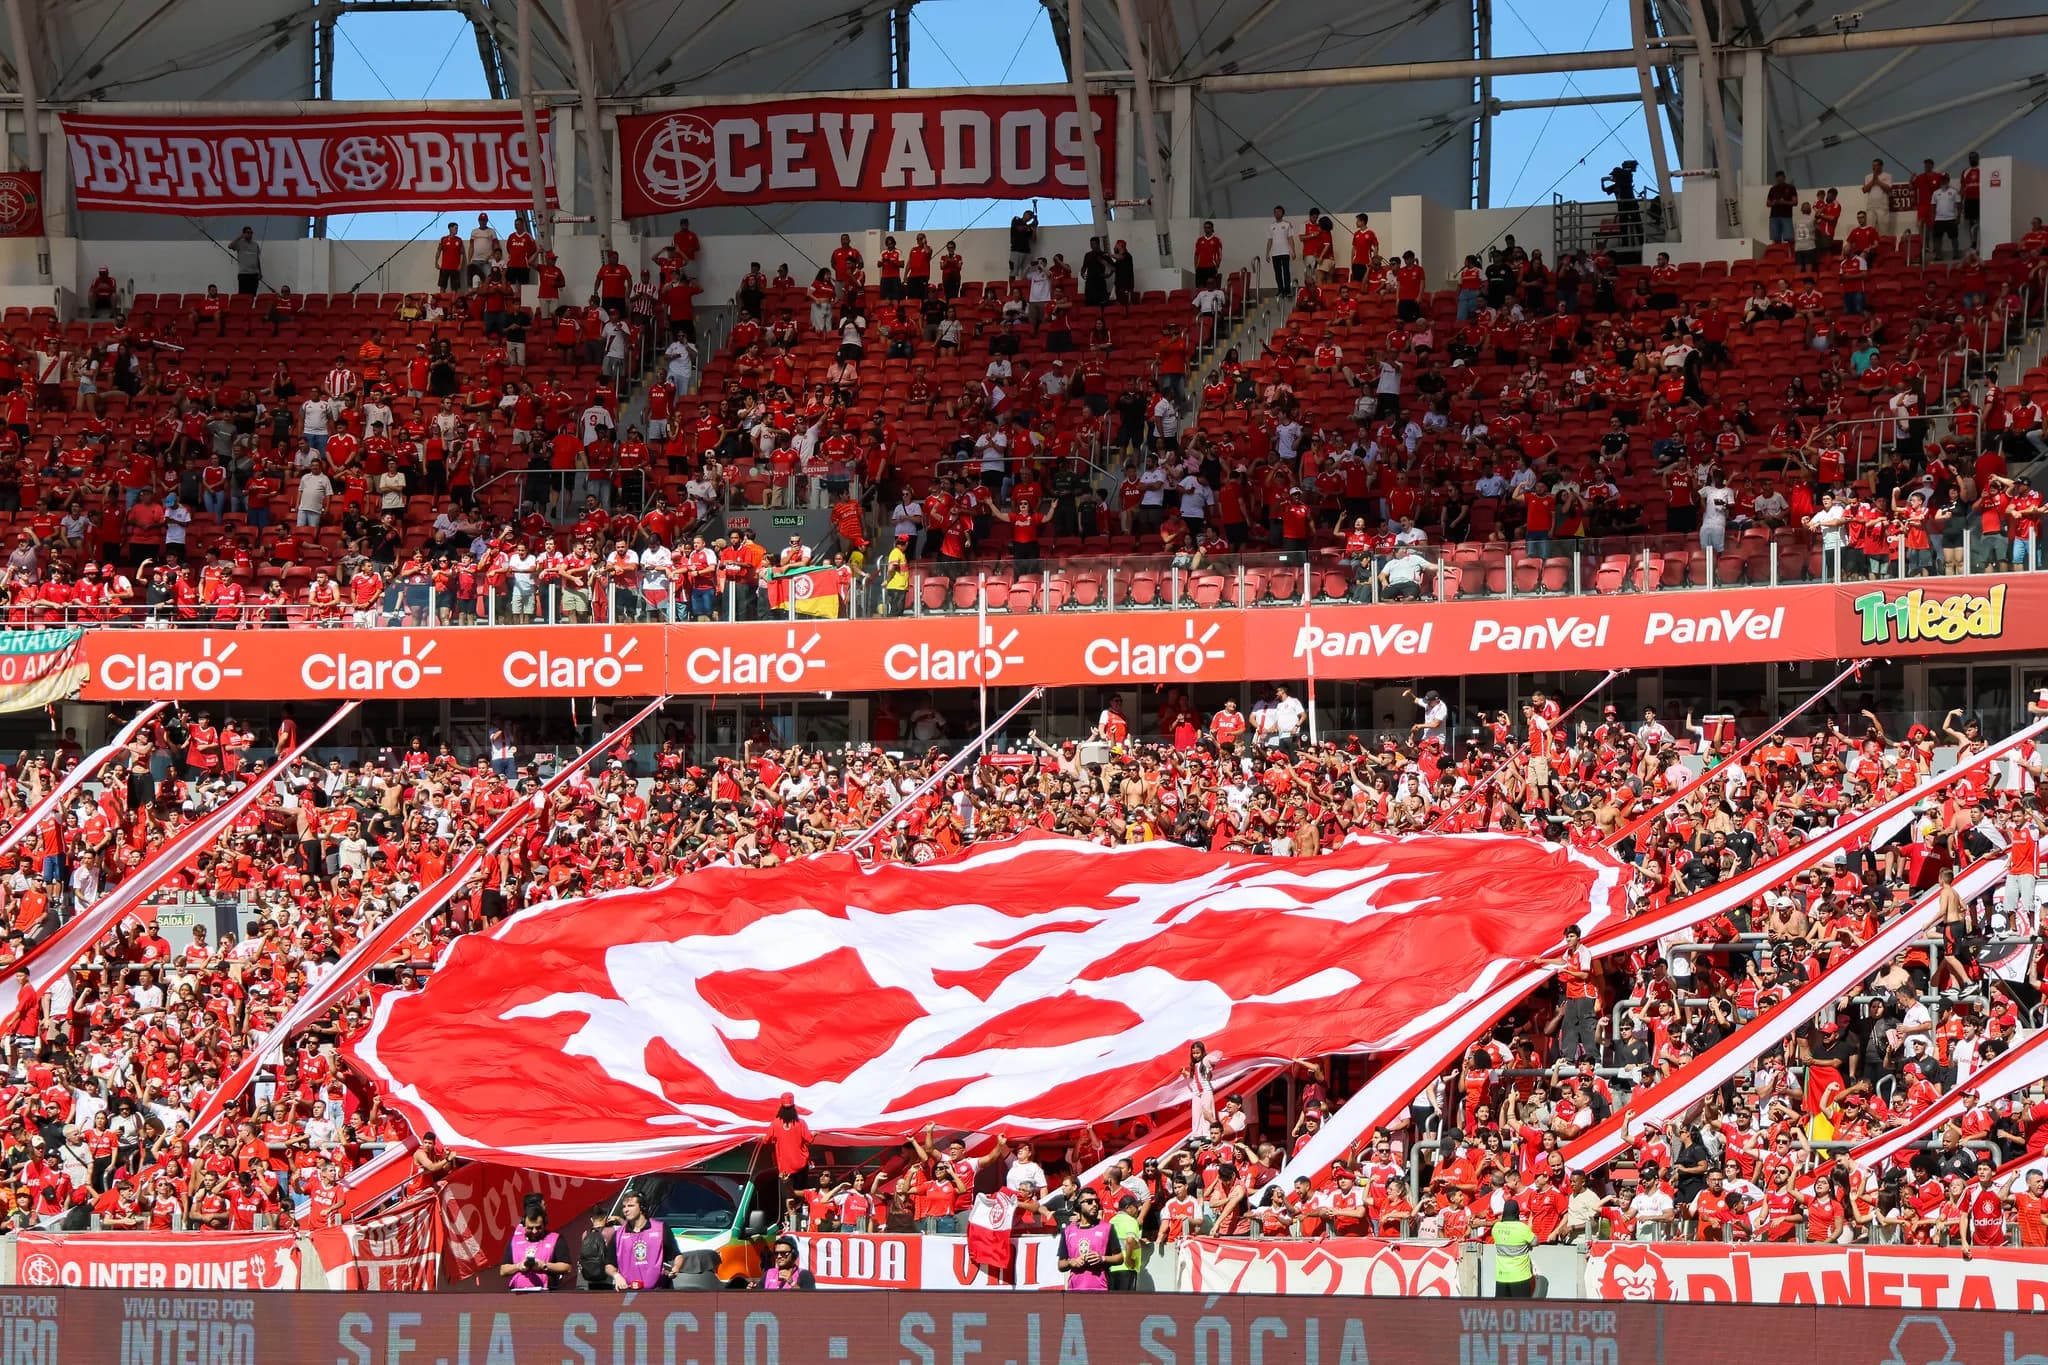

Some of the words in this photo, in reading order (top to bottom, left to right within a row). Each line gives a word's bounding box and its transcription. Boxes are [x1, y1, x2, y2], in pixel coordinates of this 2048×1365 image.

[712, 108, 1102, 193] CEVADOS
[79, 134, 318, 197] BERGA
[408, 131, 534, 193] BUS
[1893, 197, 1911, 208] 311
[589, 414, 598, 426] 9
[774, 516, 796, 525] SAÍDA
[1855, 583, 2006, 642] Trilegal
[1294, 620, 1433, 660] PanVel
[1470, 615, 1610, 653] PanVel
[1645, 606, 1785, 646] PanVel
[101, 651, 222, 691] Claro
[302, 651, 422, 690] Claro
[504, 649, 623, 688] Claro
[687, 645, 805, 684] Claro
[884, 641, 1004, 682] Claro
[1085, 636, 1204, 677] Claro
[157, 914, 183, 926] SAÍDA
[61, 1262, 82, 1287] O
[89, 1262, 167, 1288] INTER
[27, 1296, 58, 1317] POR
[123, 1298, 156, 1318] VIVA
[158, 1299, 170, 1318] O
[173, 1298, 218, 1320] INTER
[222, 1299, 254, 1321] POR
[337, 1310, 517, 1365] SEJA
[561, 1292, 780, 1365] SÓCIO
[899, 1310, 1089, 1365] SEJA
[1138, 1294, 1371, 1365] SÓCIA
[1459, 1308, 1498, 1331] VIVA
[1503, 1309, 1515, 1332] O
[1520, 1309, 1574, 1333] INTER
[1578, 1310, 1617, 1334] POR
[120, 1320, 255, 1365] INTEIRO
